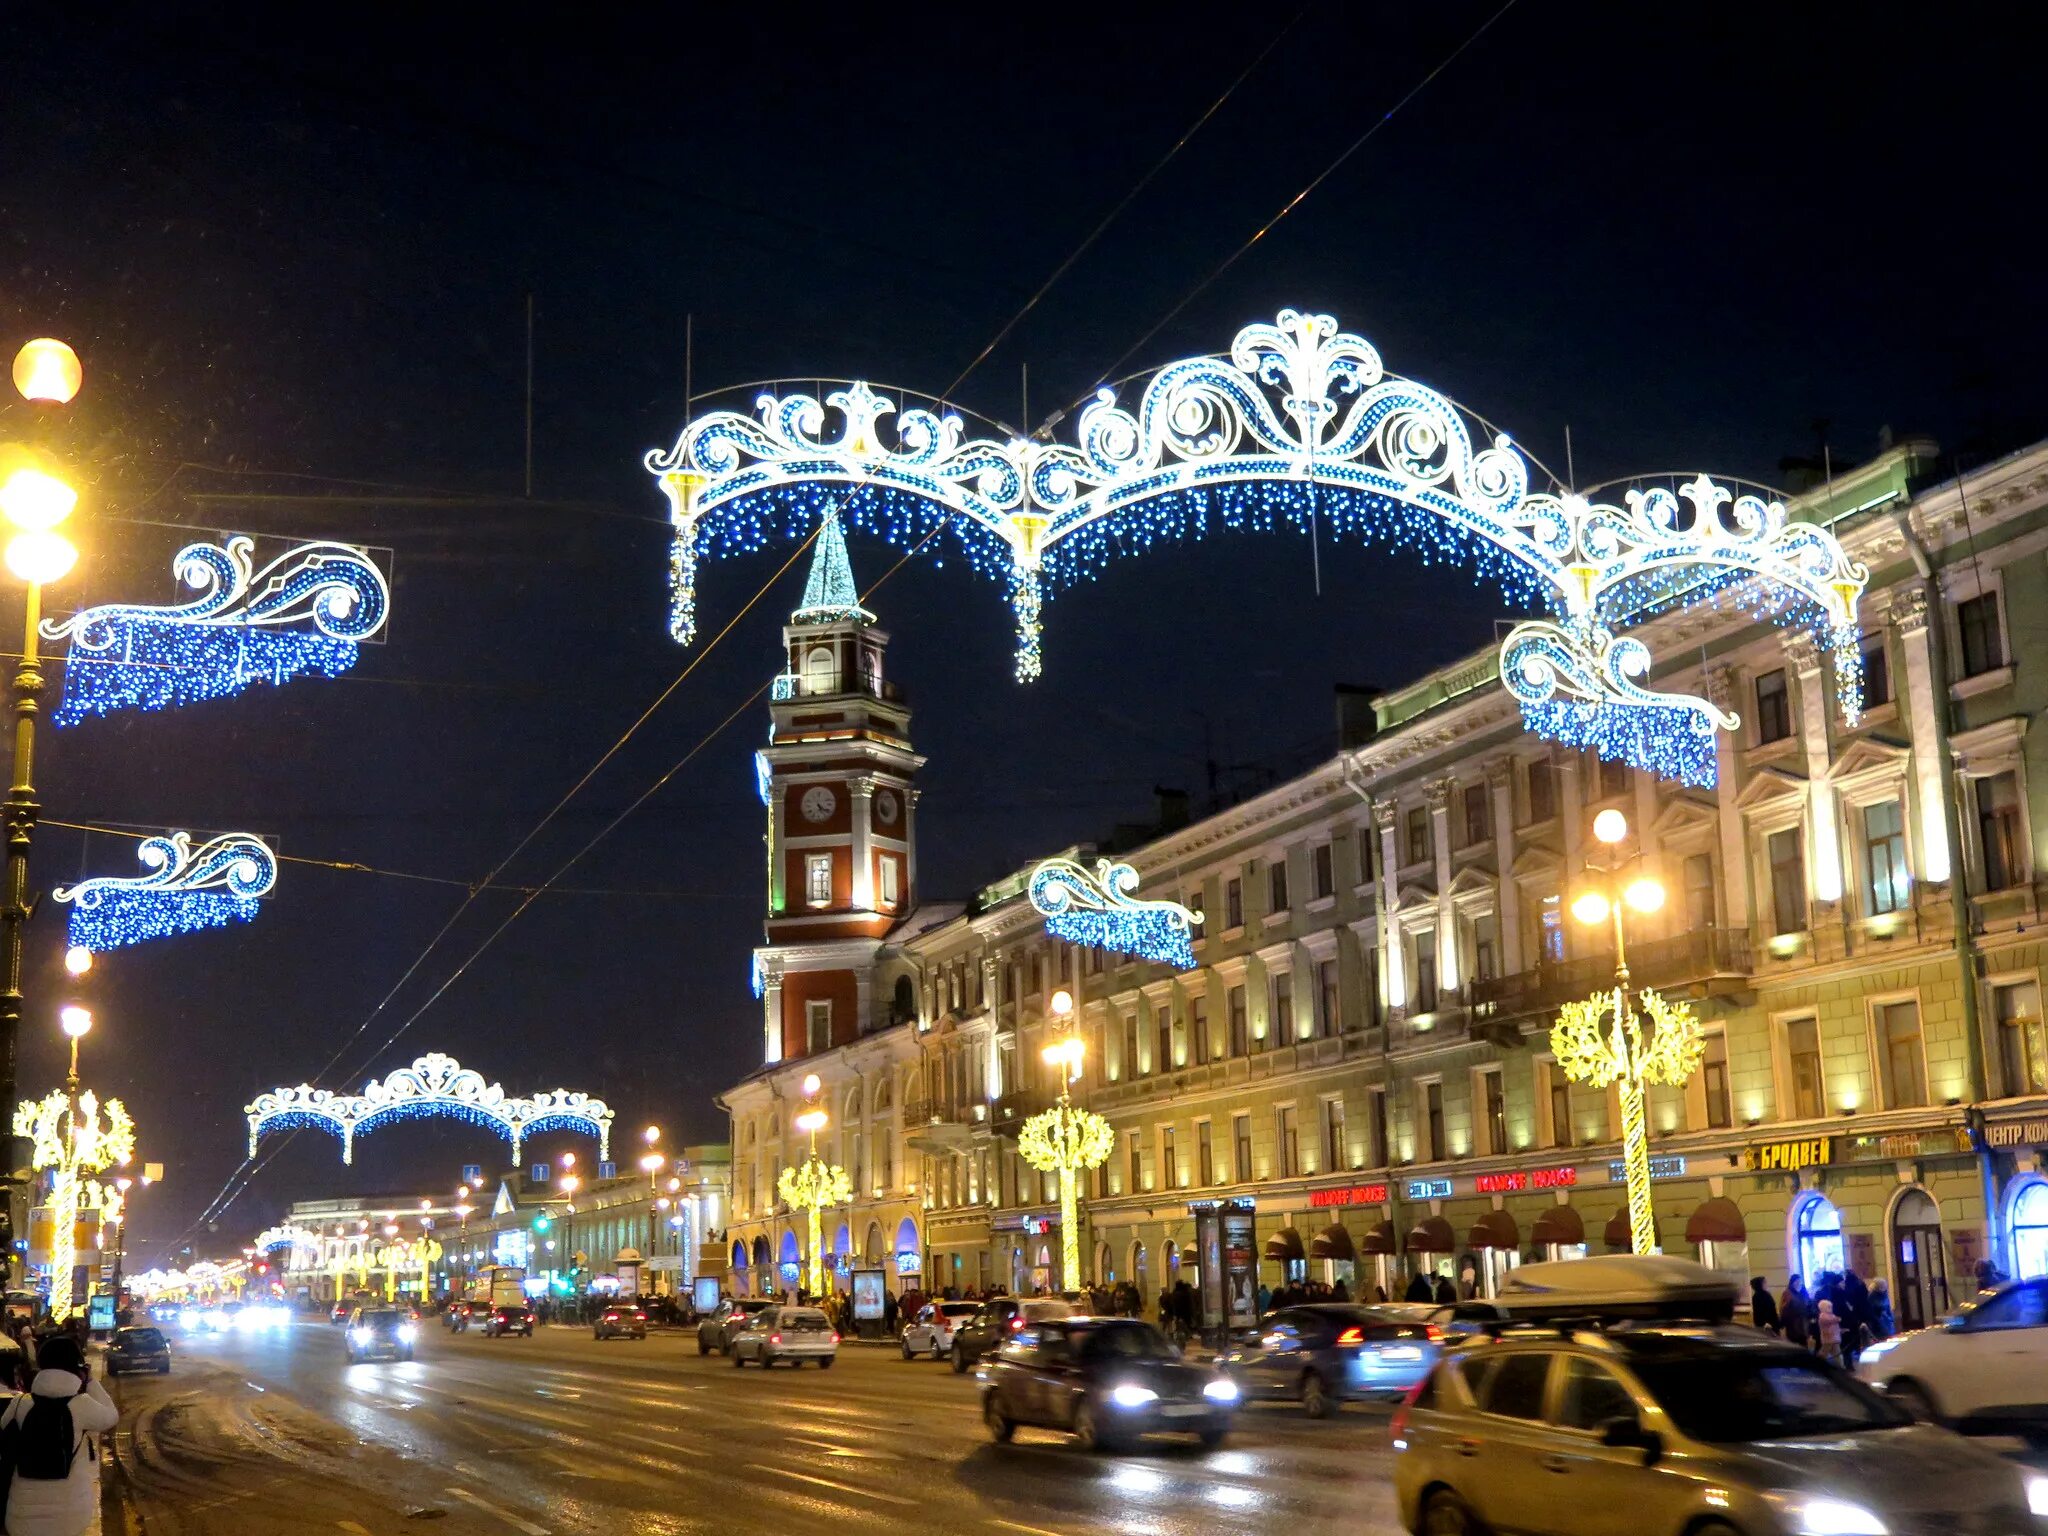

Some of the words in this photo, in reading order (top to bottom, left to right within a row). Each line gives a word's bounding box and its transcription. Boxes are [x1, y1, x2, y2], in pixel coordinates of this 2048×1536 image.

[1985, 1125, 2022, 1148] ЦЕНТР
[1761, 1136, 1829, 1171] БРОДВЕЙ
[1532, 1167, 1576, 1188] HOUSE
[1352, 1186, 1386, 1204] HOUSE
